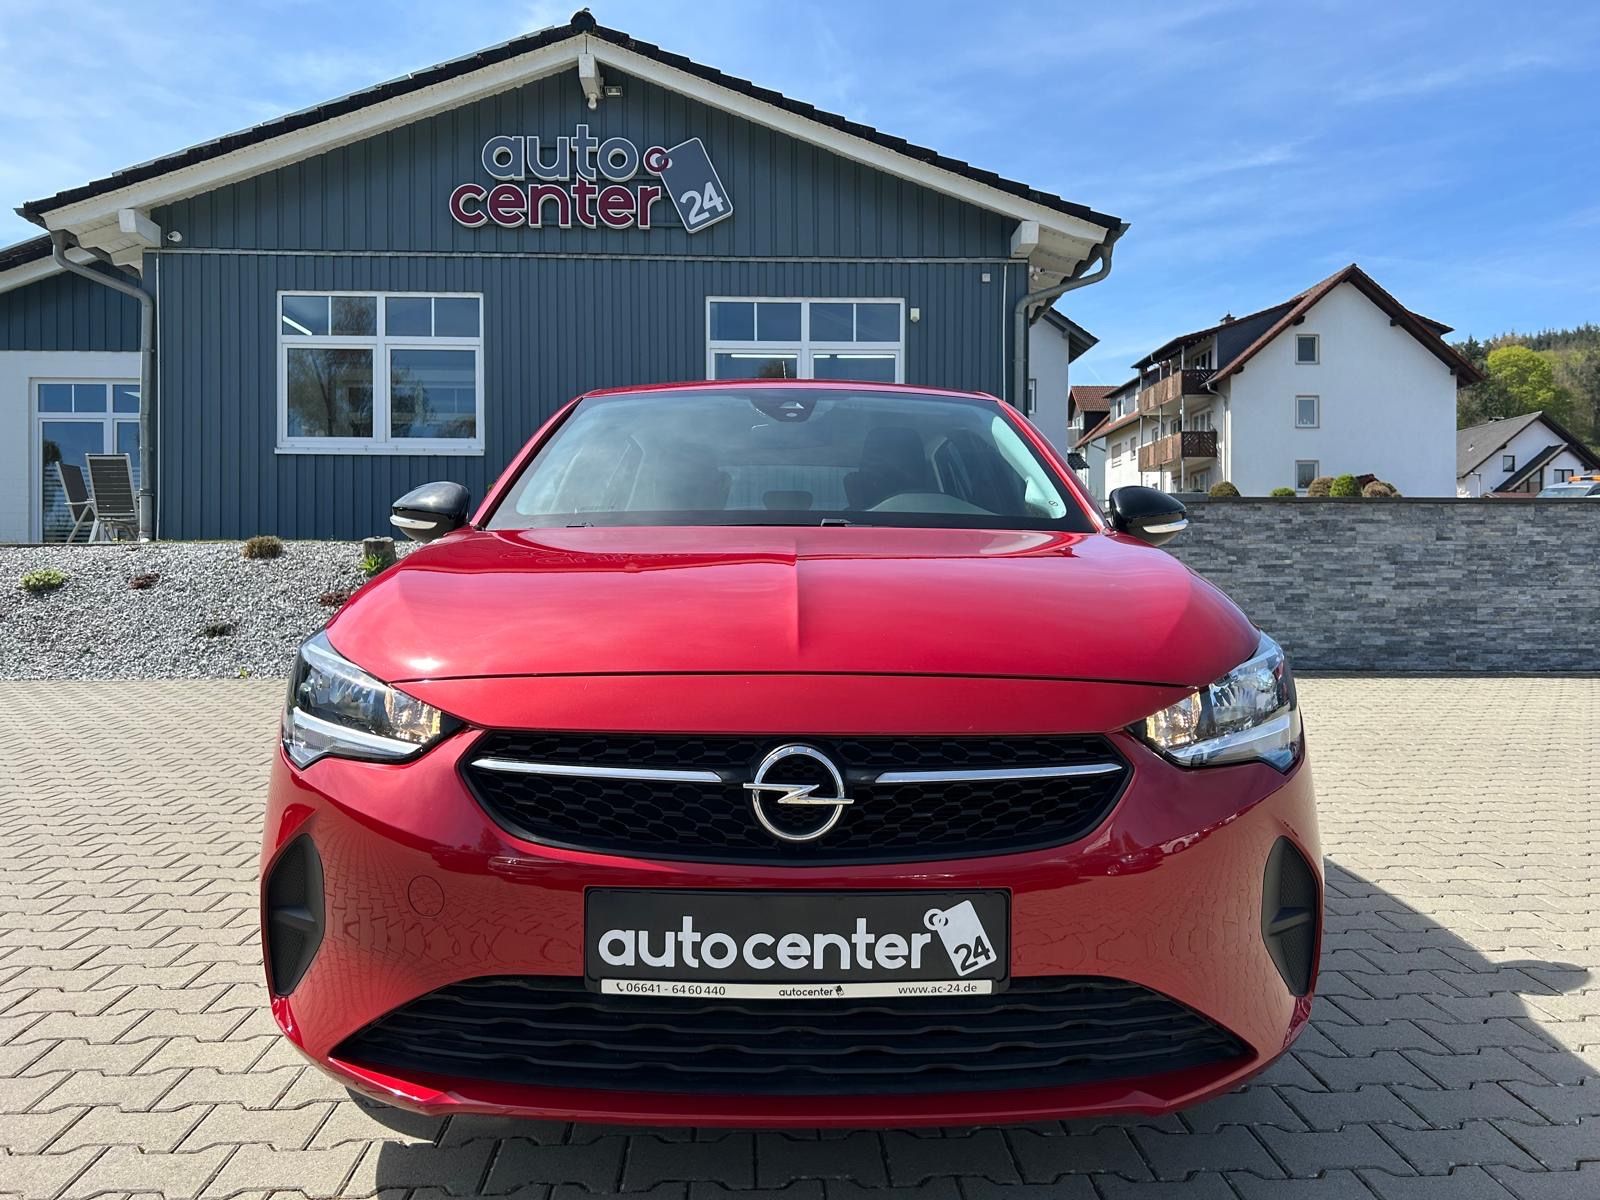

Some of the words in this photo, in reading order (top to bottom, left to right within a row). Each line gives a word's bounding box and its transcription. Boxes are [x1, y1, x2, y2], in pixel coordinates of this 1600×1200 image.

[481, 123, 639, 182] auto
[449, 173, 661, 229] center
[679, 181, 724, 225] 24
[953, 935, 991, 972] 24
[626, 982, 661, 993] 06641
[778, 986, 834, 997] autocenter
[898, 983, 978, 994] www.ac-24.de
